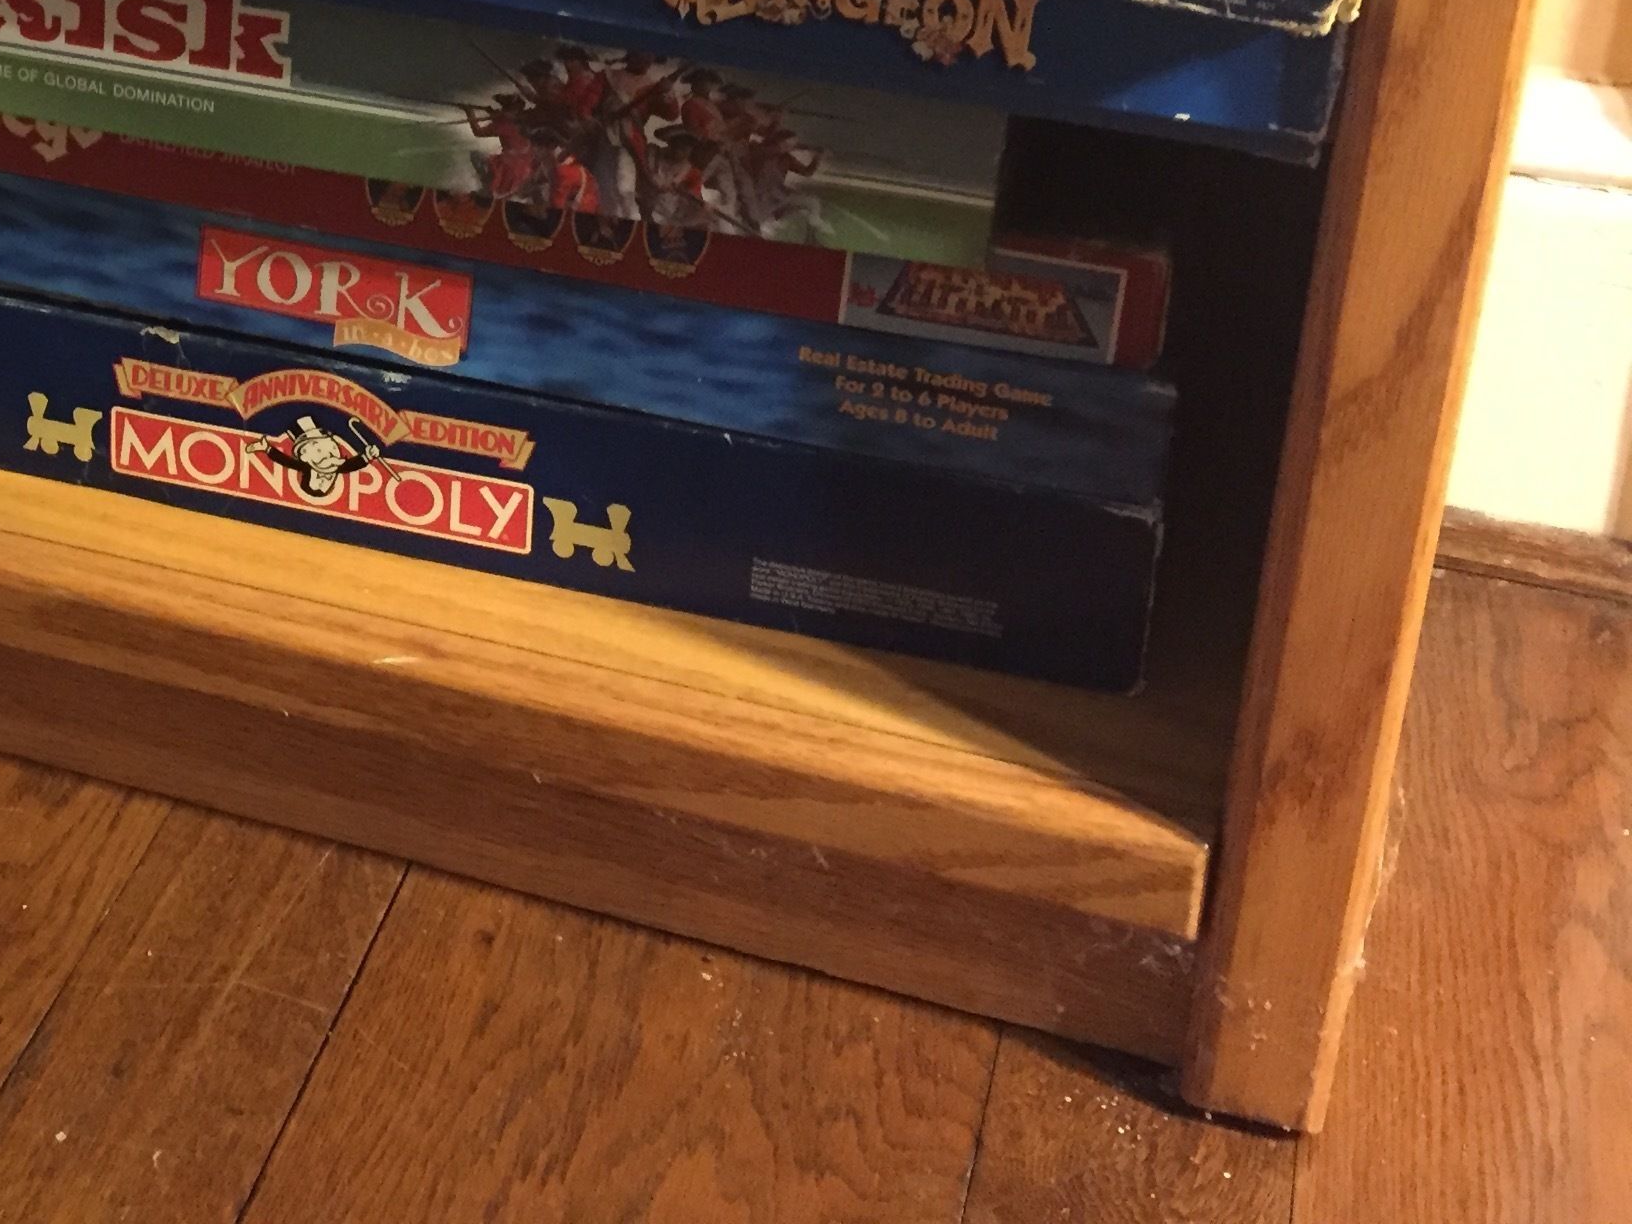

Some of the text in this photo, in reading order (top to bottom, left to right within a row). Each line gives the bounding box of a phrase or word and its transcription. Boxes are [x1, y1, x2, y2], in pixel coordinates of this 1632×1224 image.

[17, 64, 40, 84] OF
[43, 71, 107, 97] GLOBAL
[112, 81, 216, 114] DOMINATION
[209, 236, 466, 340] YORK
[797, 345, 1054, 409] Real Estate Trading Game
[835, 374, 866, 395] For
[889, 384, 914, 405] to
[918, 389, 931, 408] 6
[936, 394, 1010, 423] Players
[129, 364, 518, 456] DELUXE ANNIVERSARY EDITION
[838, 398, 999, 442] Ages 8 to Adult
